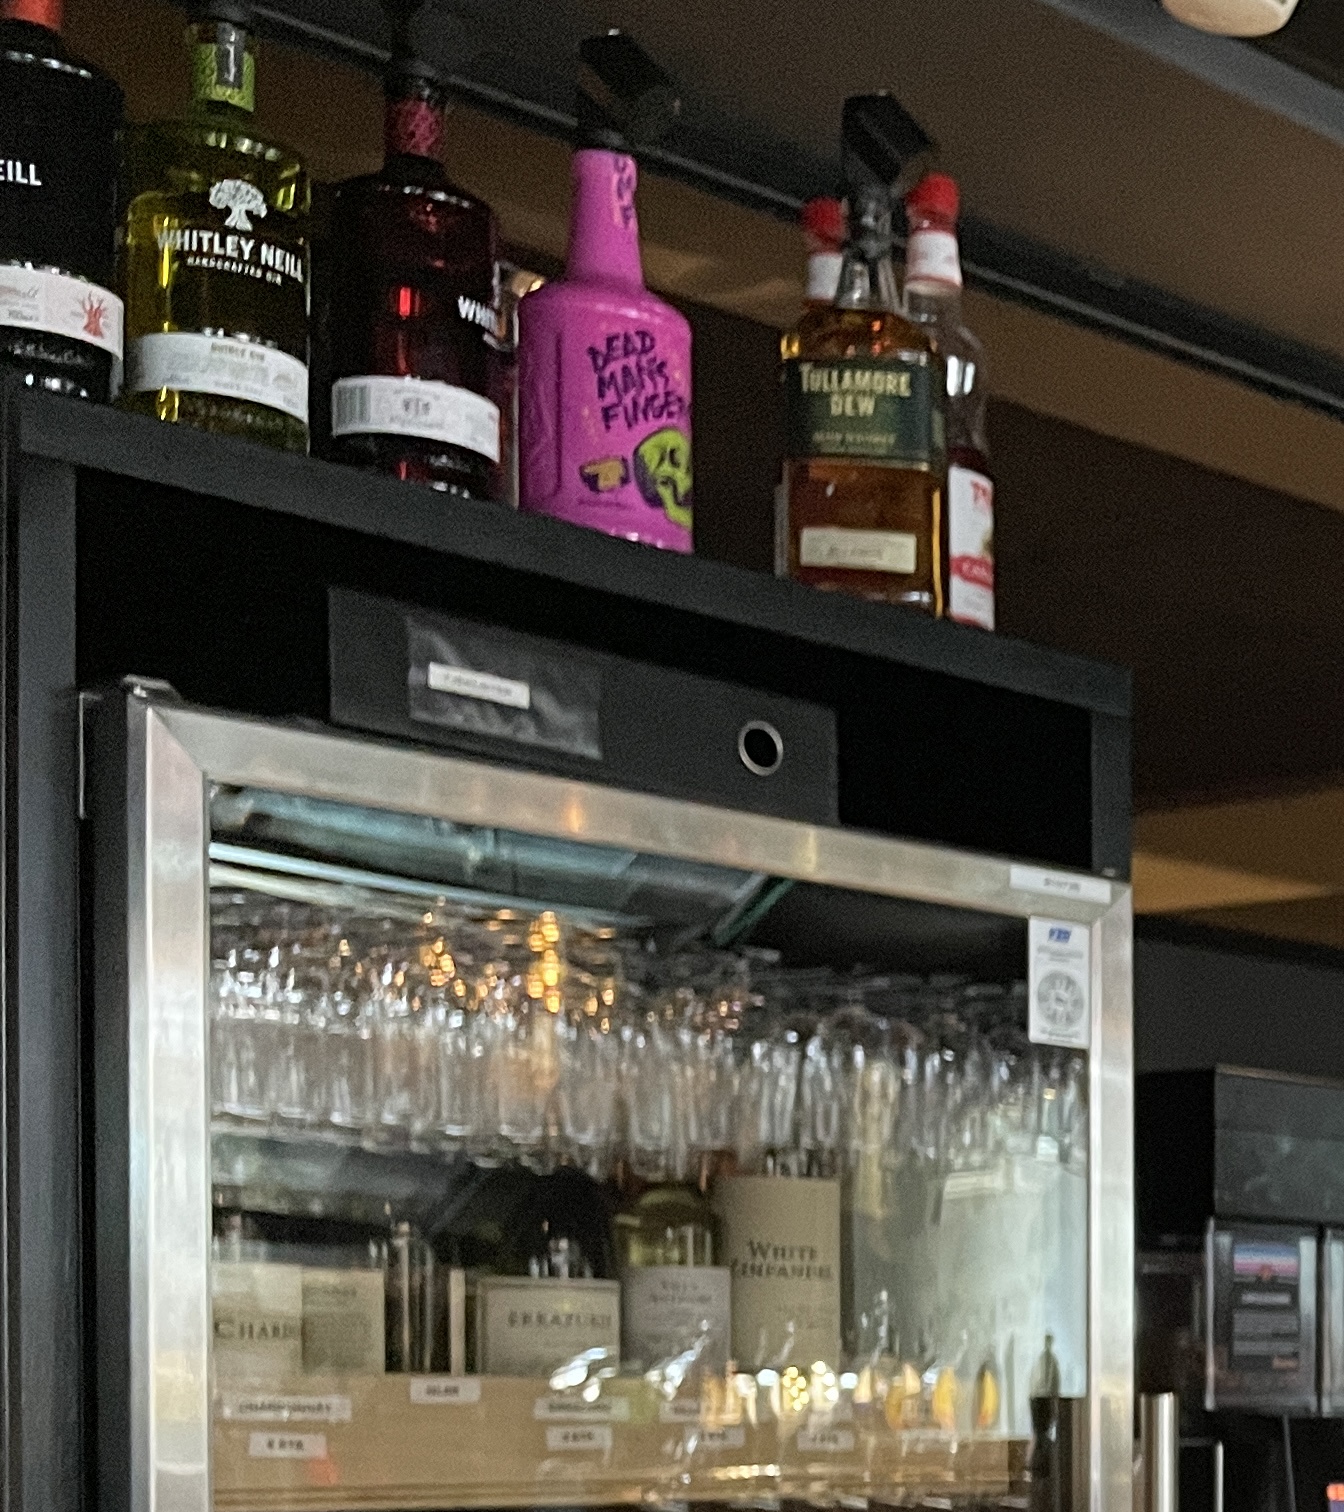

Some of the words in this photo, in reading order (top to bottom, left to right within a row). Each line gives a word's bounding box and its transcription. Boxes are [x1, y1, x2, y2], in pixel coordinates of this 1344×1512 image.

[157, 228, 254, 260] WHITLEY
[260, 241, 304, 283] NEILL
[586, 330, 655, 374] DEAD
[799, 362, 912, 398] TULLAMORE
[830, 394, 876, 417] DEW
[748, 1238, 815, 1263] WHITE
